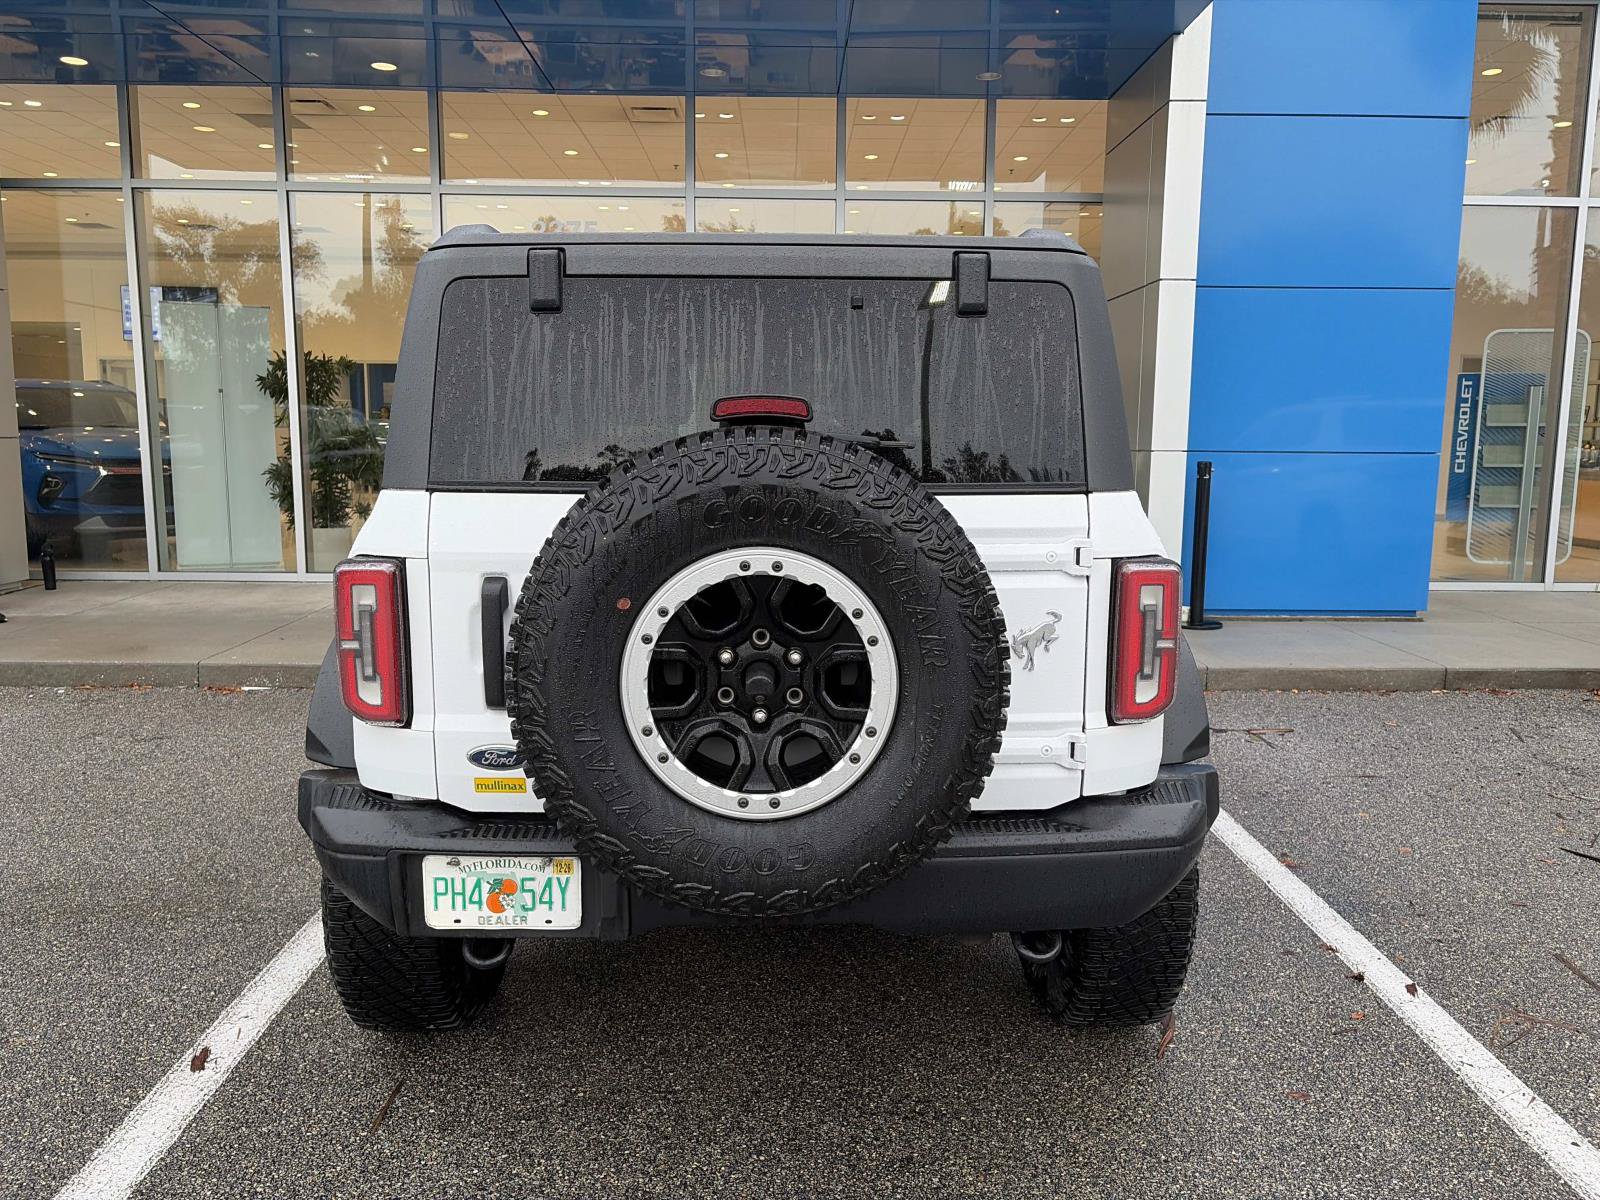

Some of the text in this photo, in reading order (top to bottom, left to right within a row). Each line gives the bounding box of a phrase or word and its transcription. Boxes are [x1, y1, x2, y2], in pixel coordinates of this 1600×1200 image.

[1454, 377, 1473, 474] CHEVROLET
[481, 750, 517, 765] Ford
[475, 780, 524, 791] mullinax
[458, 858, 546, 874] MYFLORIDA.COM
[433, 877, 571, 912] PH4 54Y
[477, 915, 528, 926] DEALER
